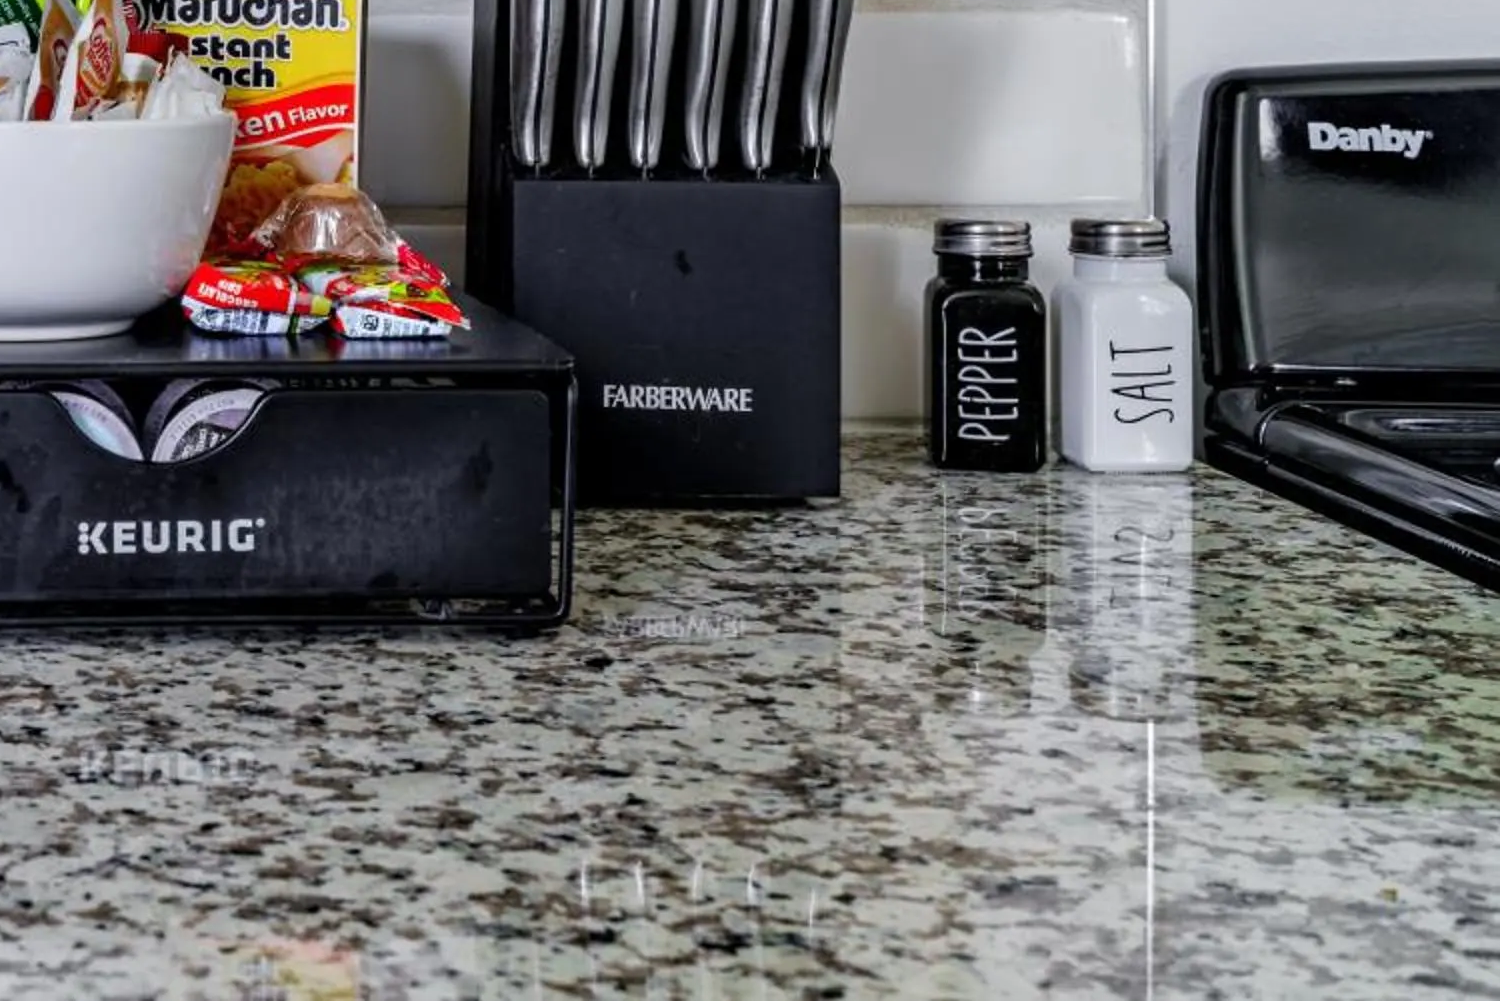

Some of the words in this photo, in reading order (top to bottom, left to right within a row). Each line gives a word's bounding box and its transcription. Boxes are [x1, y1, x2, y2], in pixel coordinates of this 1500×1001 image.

[191, 34, 291, 60] stant
[287, 103, 349, 126] Flavor
[1307, 121, 1426, 160] Danby
[602, 382, 754, 412] FARBERWARE
[957, 326, 1019, 441] PEPPER
[1109, 339, 1177, 424] SALT
[77, 518, 257, 555] KEURIG
